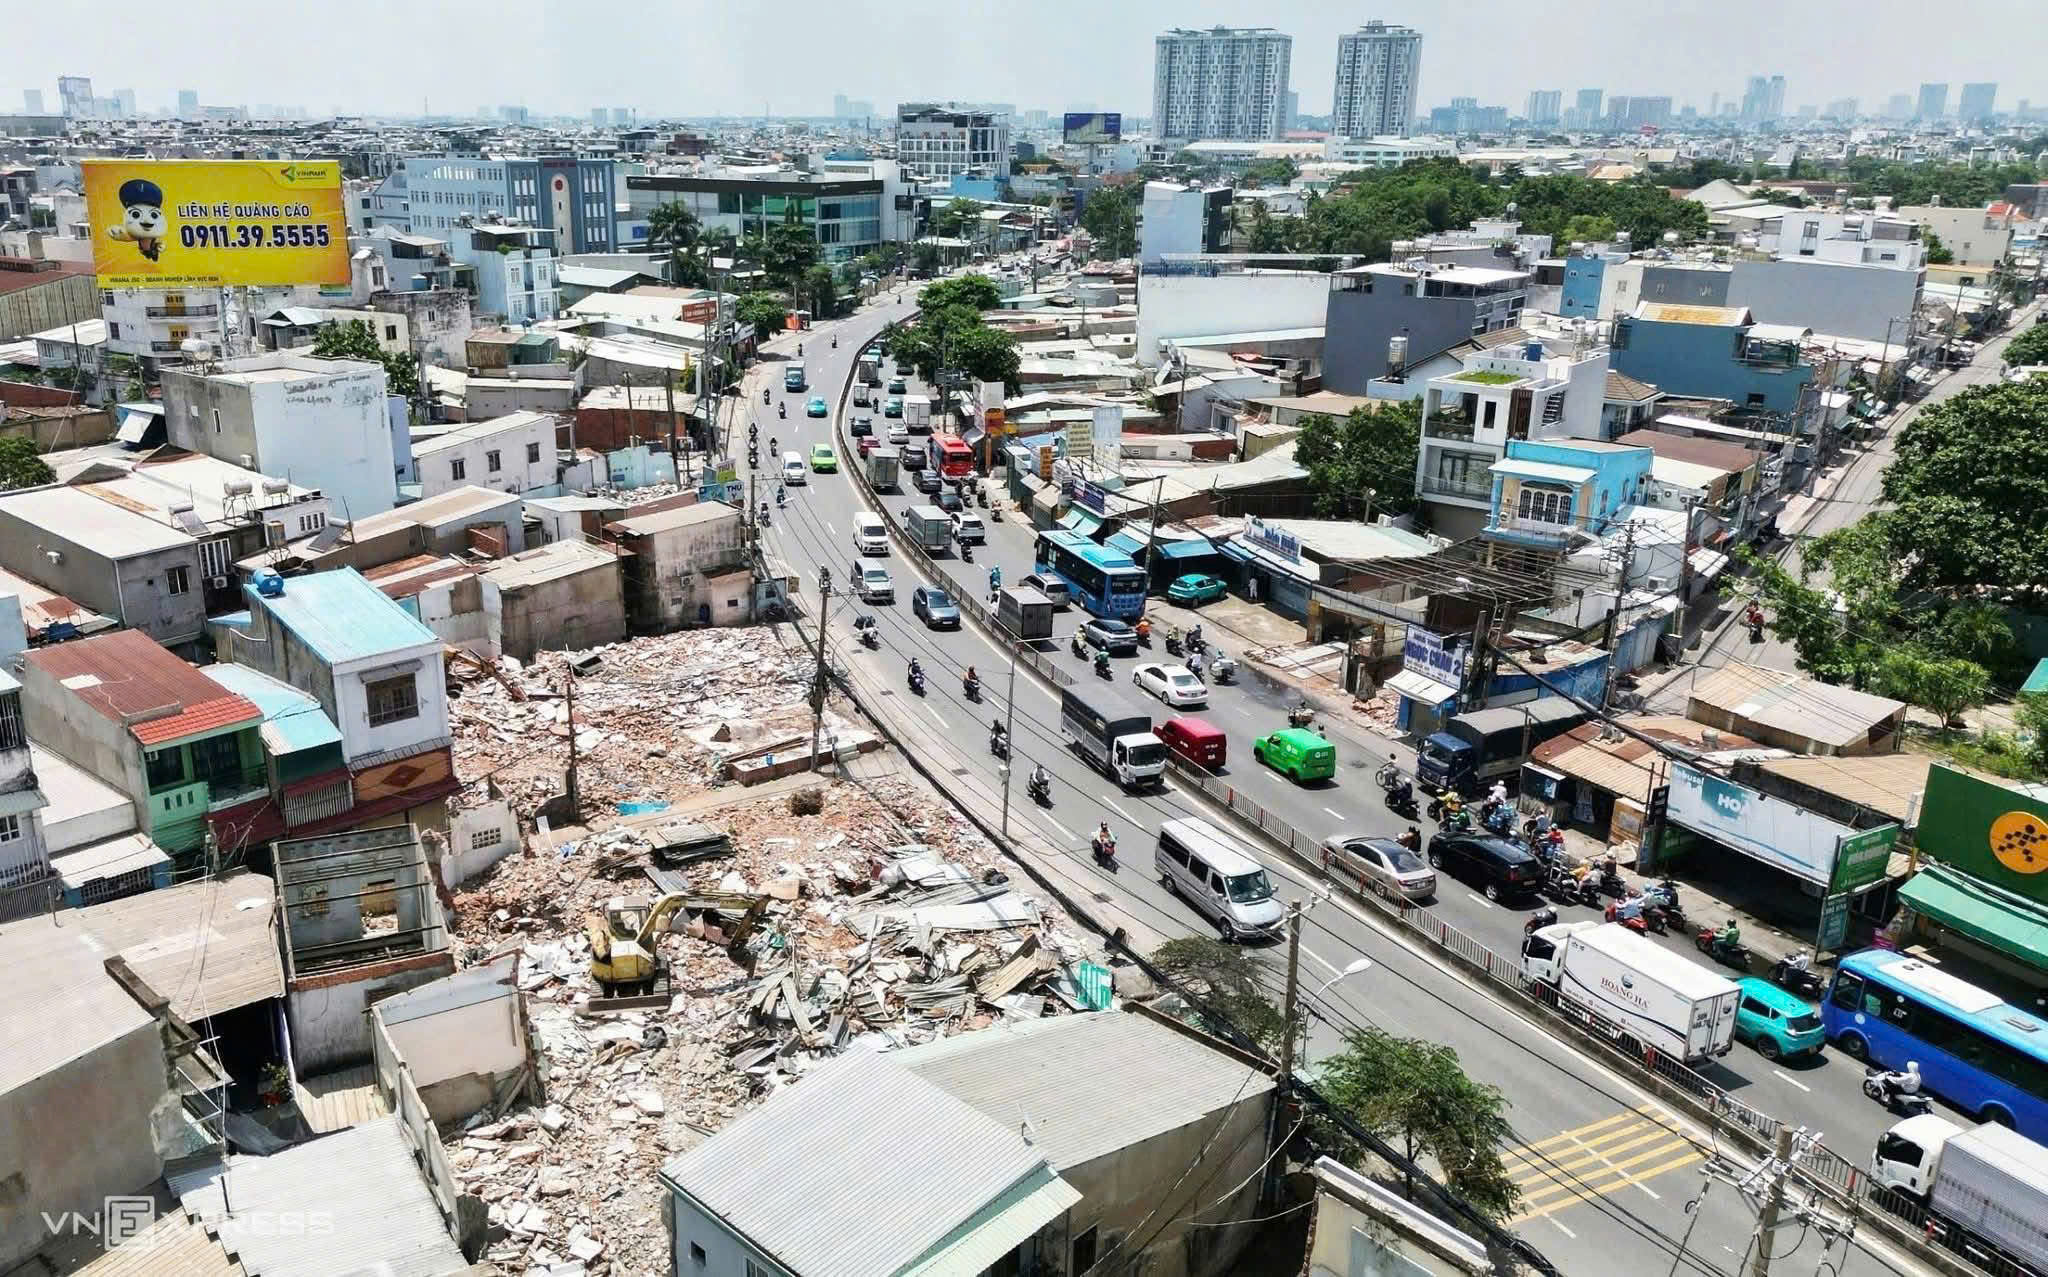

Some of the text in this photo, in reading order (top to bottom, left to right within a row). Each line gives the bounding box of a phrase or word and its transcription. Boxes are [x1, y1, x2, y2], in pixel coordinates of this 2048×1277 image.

[177, 200, 310, 221] LIÊN HỆ QUẢNG CÁO
[180, 224, 330, 248] 0911.39.5555
[1453, 659, 1461, 677] 2
